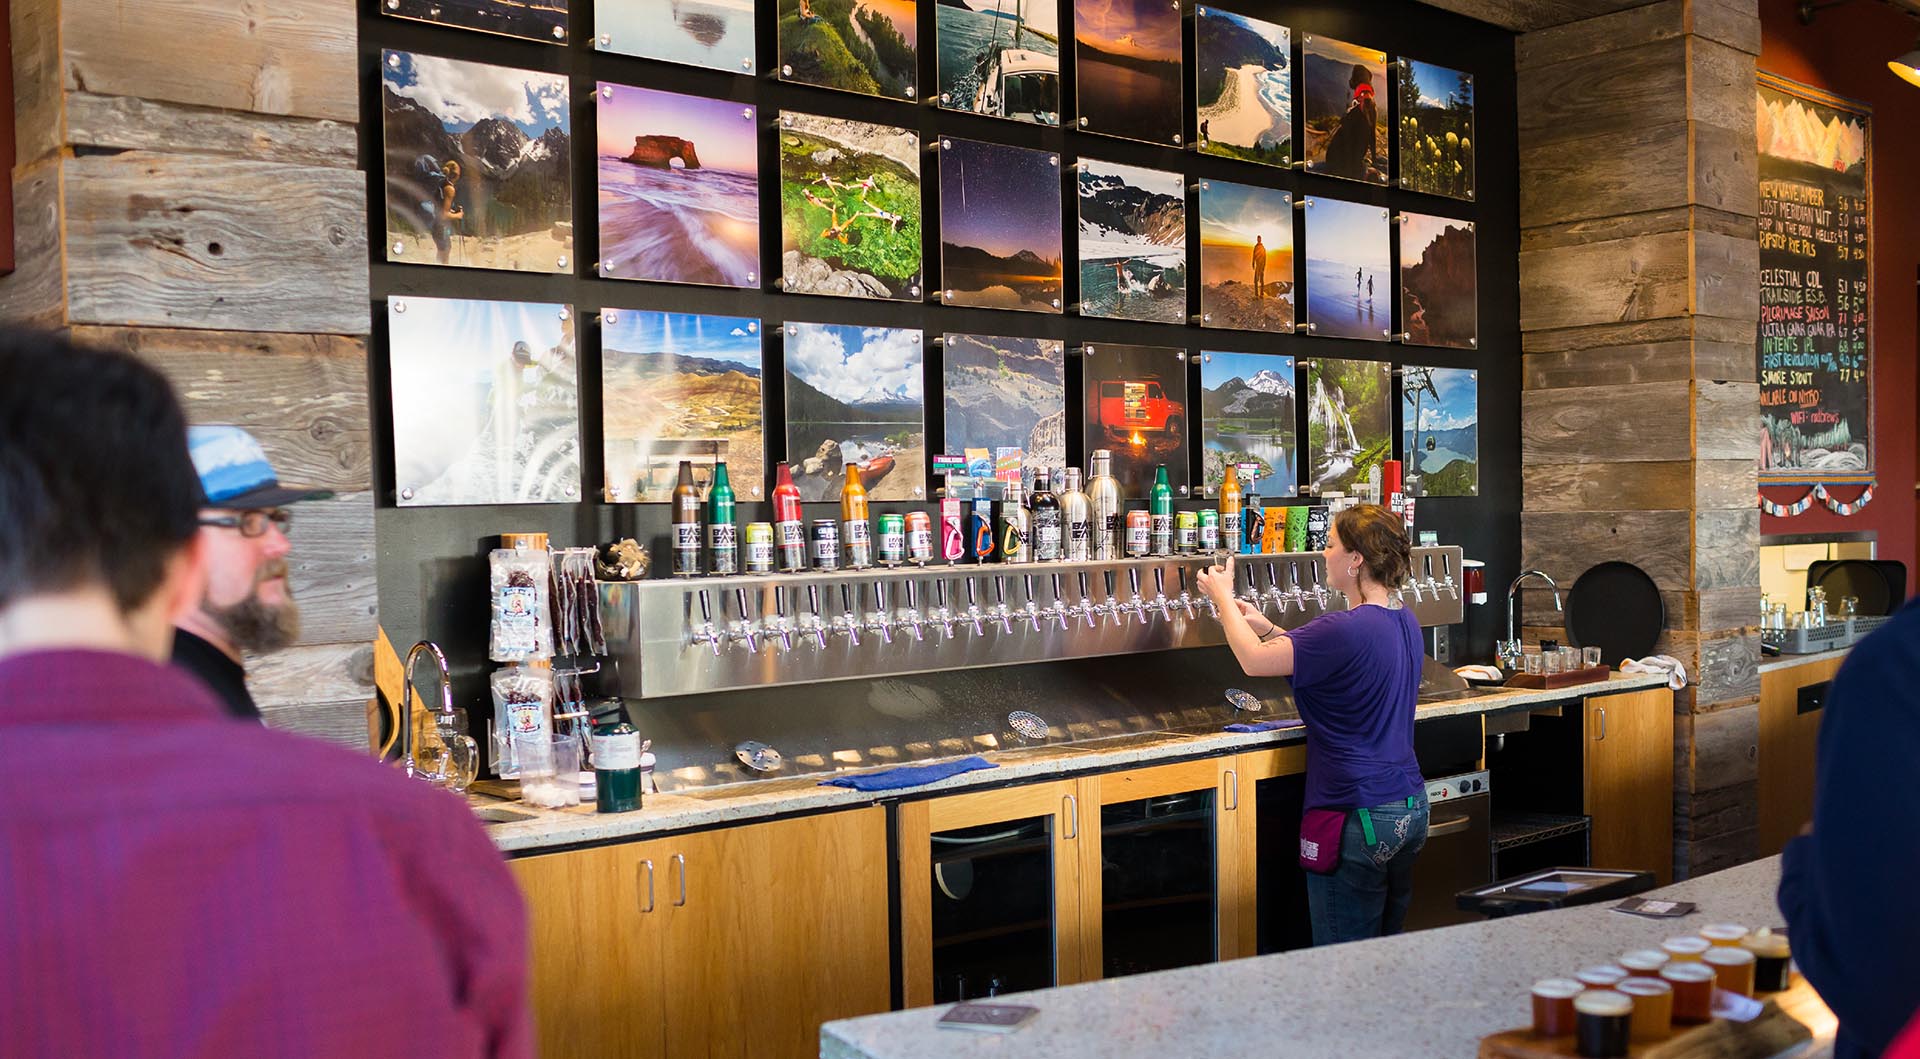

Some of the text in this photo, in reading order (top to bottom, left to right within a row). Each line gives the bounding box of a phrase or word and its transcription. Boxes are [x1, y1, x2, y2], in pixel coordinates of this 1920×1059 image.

[1799, 185, 1824, 208] AMBER
[1759, 199, 1778, 215] LOST
[1780, 201, 1814, 224] MERIDIAN
[1815, 208, 1832, 228] WIT
[1758, 217, 1773, 230] HOP
[1775, 220, 1784, 233] IN
[1785, 221, 1798, 235] THE
[1798, 224, 1813, 238] POOL
[1815, 227, 1838, 244] HELLES
[1759, 230, 1787, 250] RIPSTOP
[1788, 237, 1801, 254] RYE
[1802, 239, 1816, 257] PILS
[1759, 268, 1803, 288] CELESTIAL
[1806, 270, 1823, 289] CDL
[1759, 287, 1804, 305] TRAILSIDE
[1761, 304, 1804, 323] PILGRIMAGE
[1805, 305, 1830, 323] SAISON
[1762, 322, 1786, 337] ULTRA
[1786, 321, 1806, 337] GNAR
[1807, 321, 1826, 337] GNAR
[1826, 322, 1836, 338] IPA
[1803, 337, 1815, 352] IPL
[1764, 352, 1781, 369] FIRST
[1783, 352, 1820, 369] REVOLUTION
[1790, 370, 1813, 385] STOUT
[1789, 390, 1798, 403] ON
